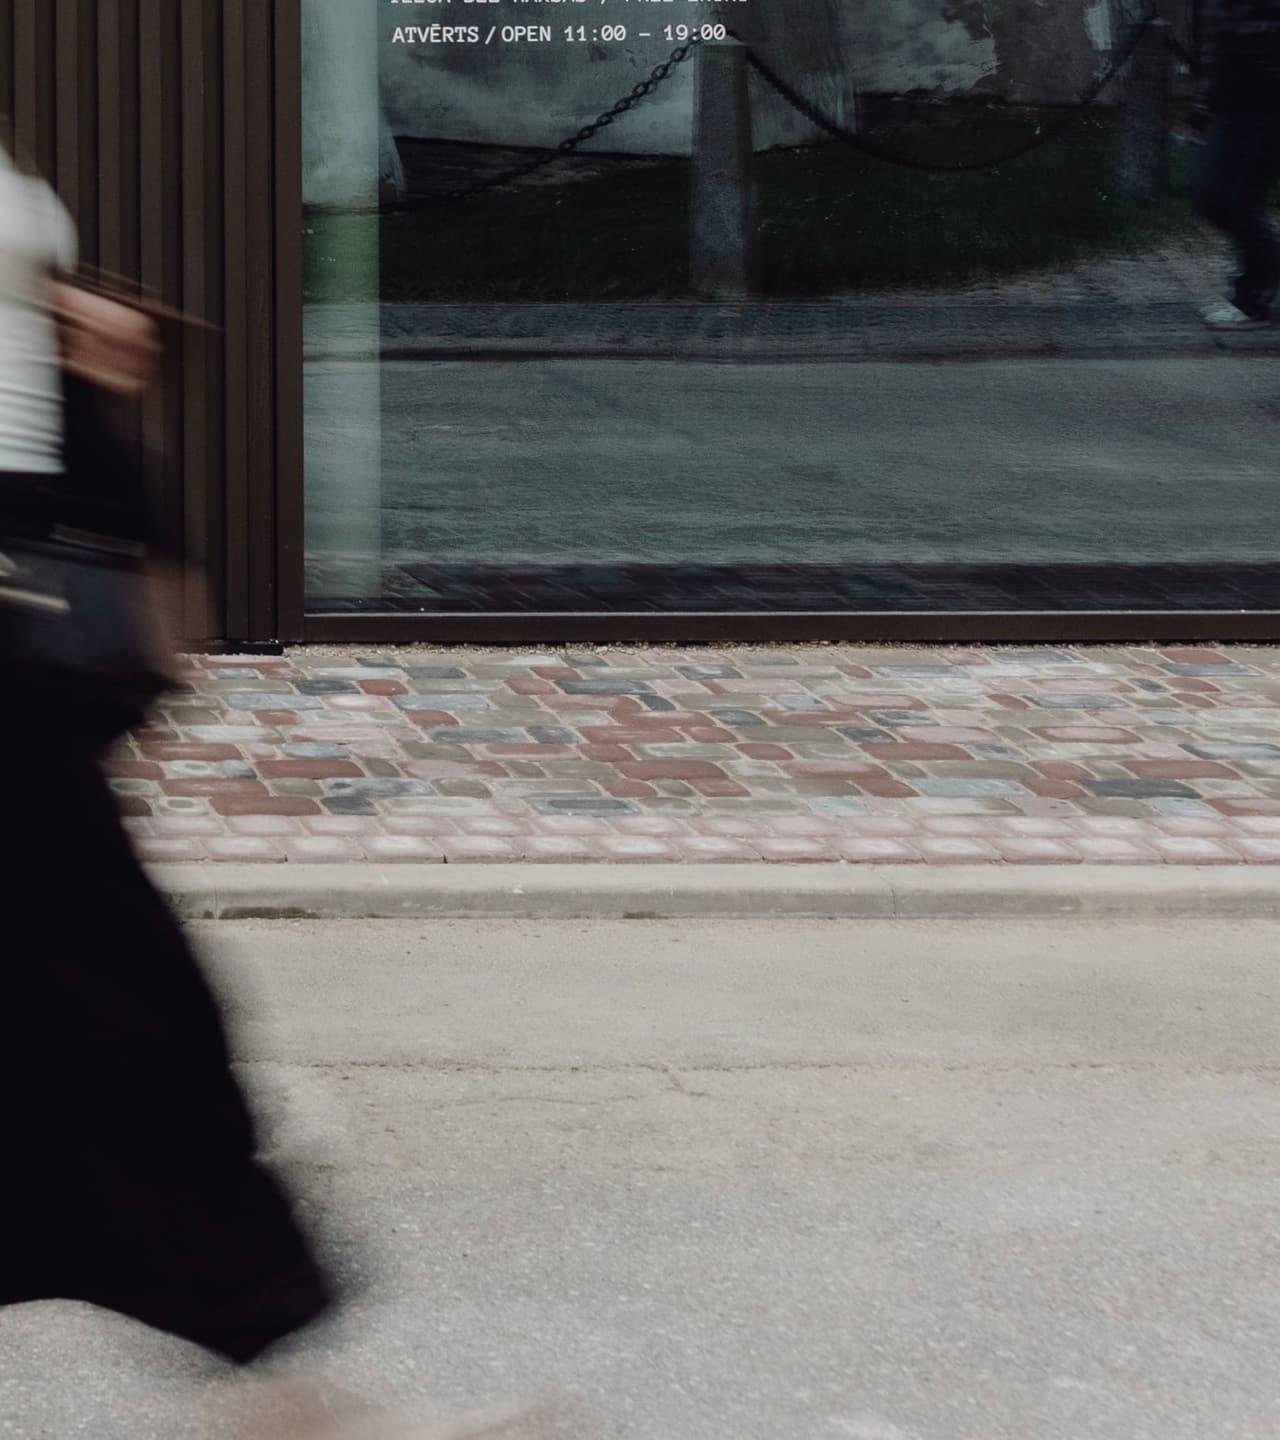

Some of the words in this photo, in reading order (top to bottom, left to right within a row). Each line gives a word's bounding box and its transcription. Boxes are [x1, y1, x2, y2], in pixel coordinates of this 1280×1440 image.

[392, 23, 479, 44] ATVĒRTS
[502, 26, 551, 43] OPEN
[564, 25, 626, 42] 11:00
[664, 23, 726, 42] 19:00
